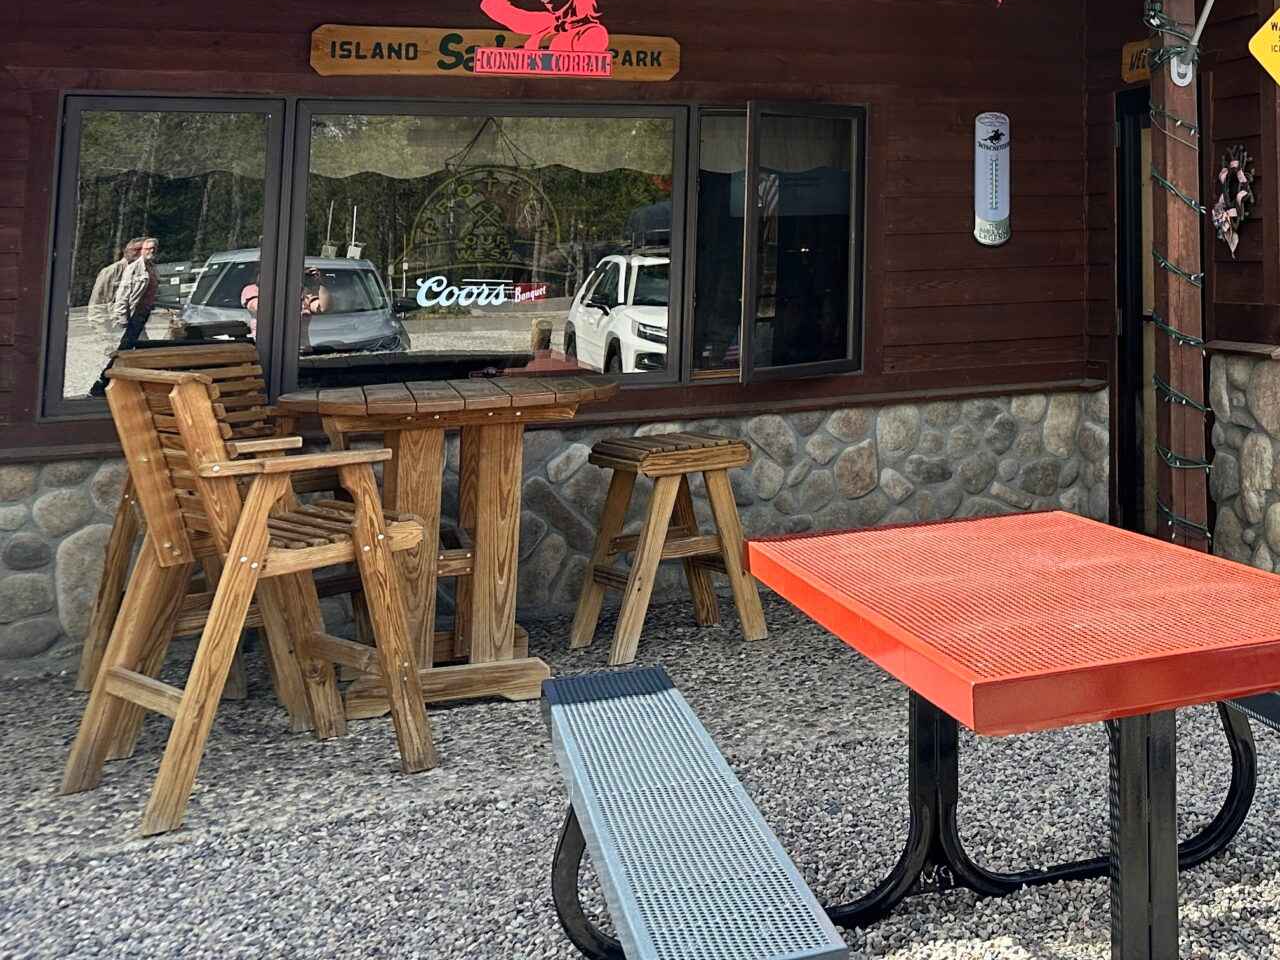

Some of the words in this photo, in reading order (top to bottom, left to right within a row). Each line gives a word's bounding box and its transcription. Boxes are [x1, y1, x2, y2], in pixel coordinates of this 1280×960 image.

[330, 40, 419, 61] ISLAND
[552, 53, 607, 73] CORRAL
[416, 276, 508, 307] Coors
